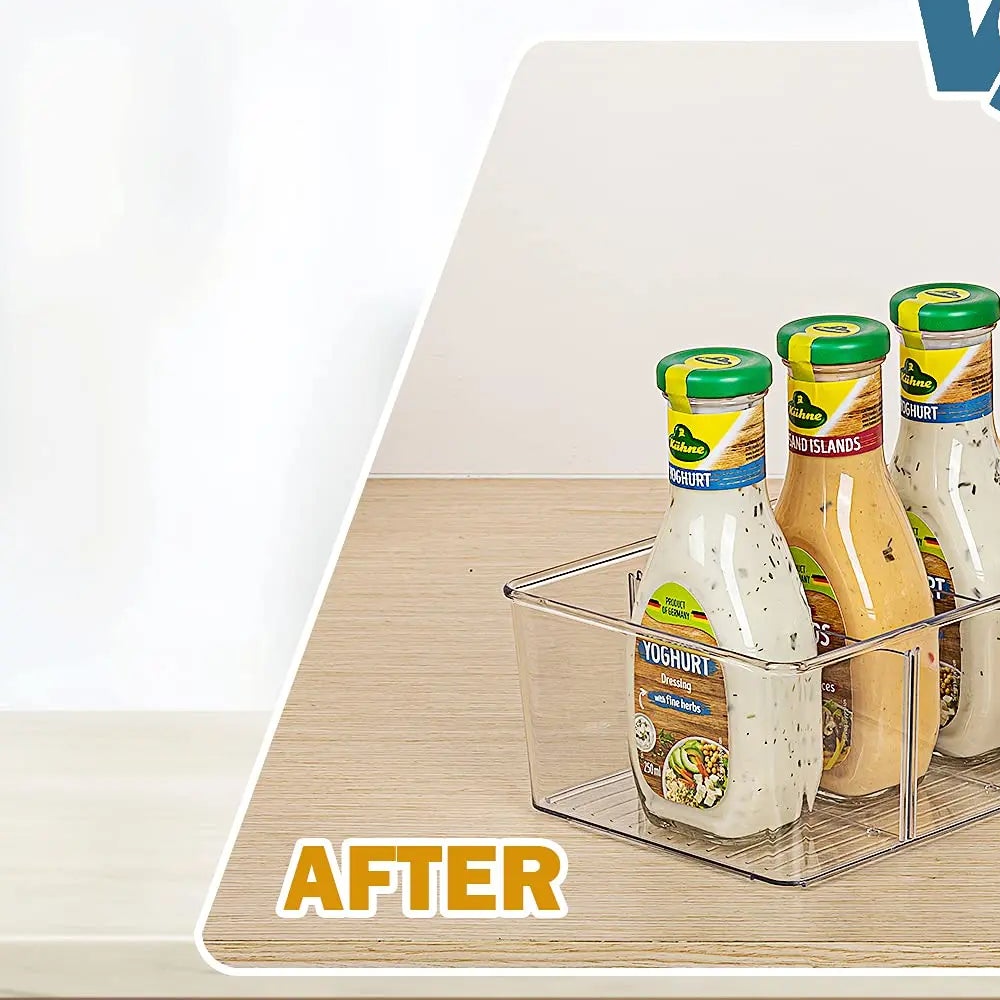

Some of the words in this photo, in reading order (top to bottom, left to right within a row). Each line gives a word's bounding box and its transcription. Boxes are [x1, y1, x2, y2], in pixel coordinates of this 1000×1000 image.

[810, 437, 862, 455] ISLANDS
[665, 596, 687, 610] PRODUCT
[661, 605, 668, 615] OF
[668, 606, 691, 620] GERMANY
[642, 640, 711, 676] YOGHURT
[660, 672, 693, 694] Dressing
[821, 681, 836, 694] ces
[666, 693, 681, 709] fine
[680, 699, 702, 715] herbs
